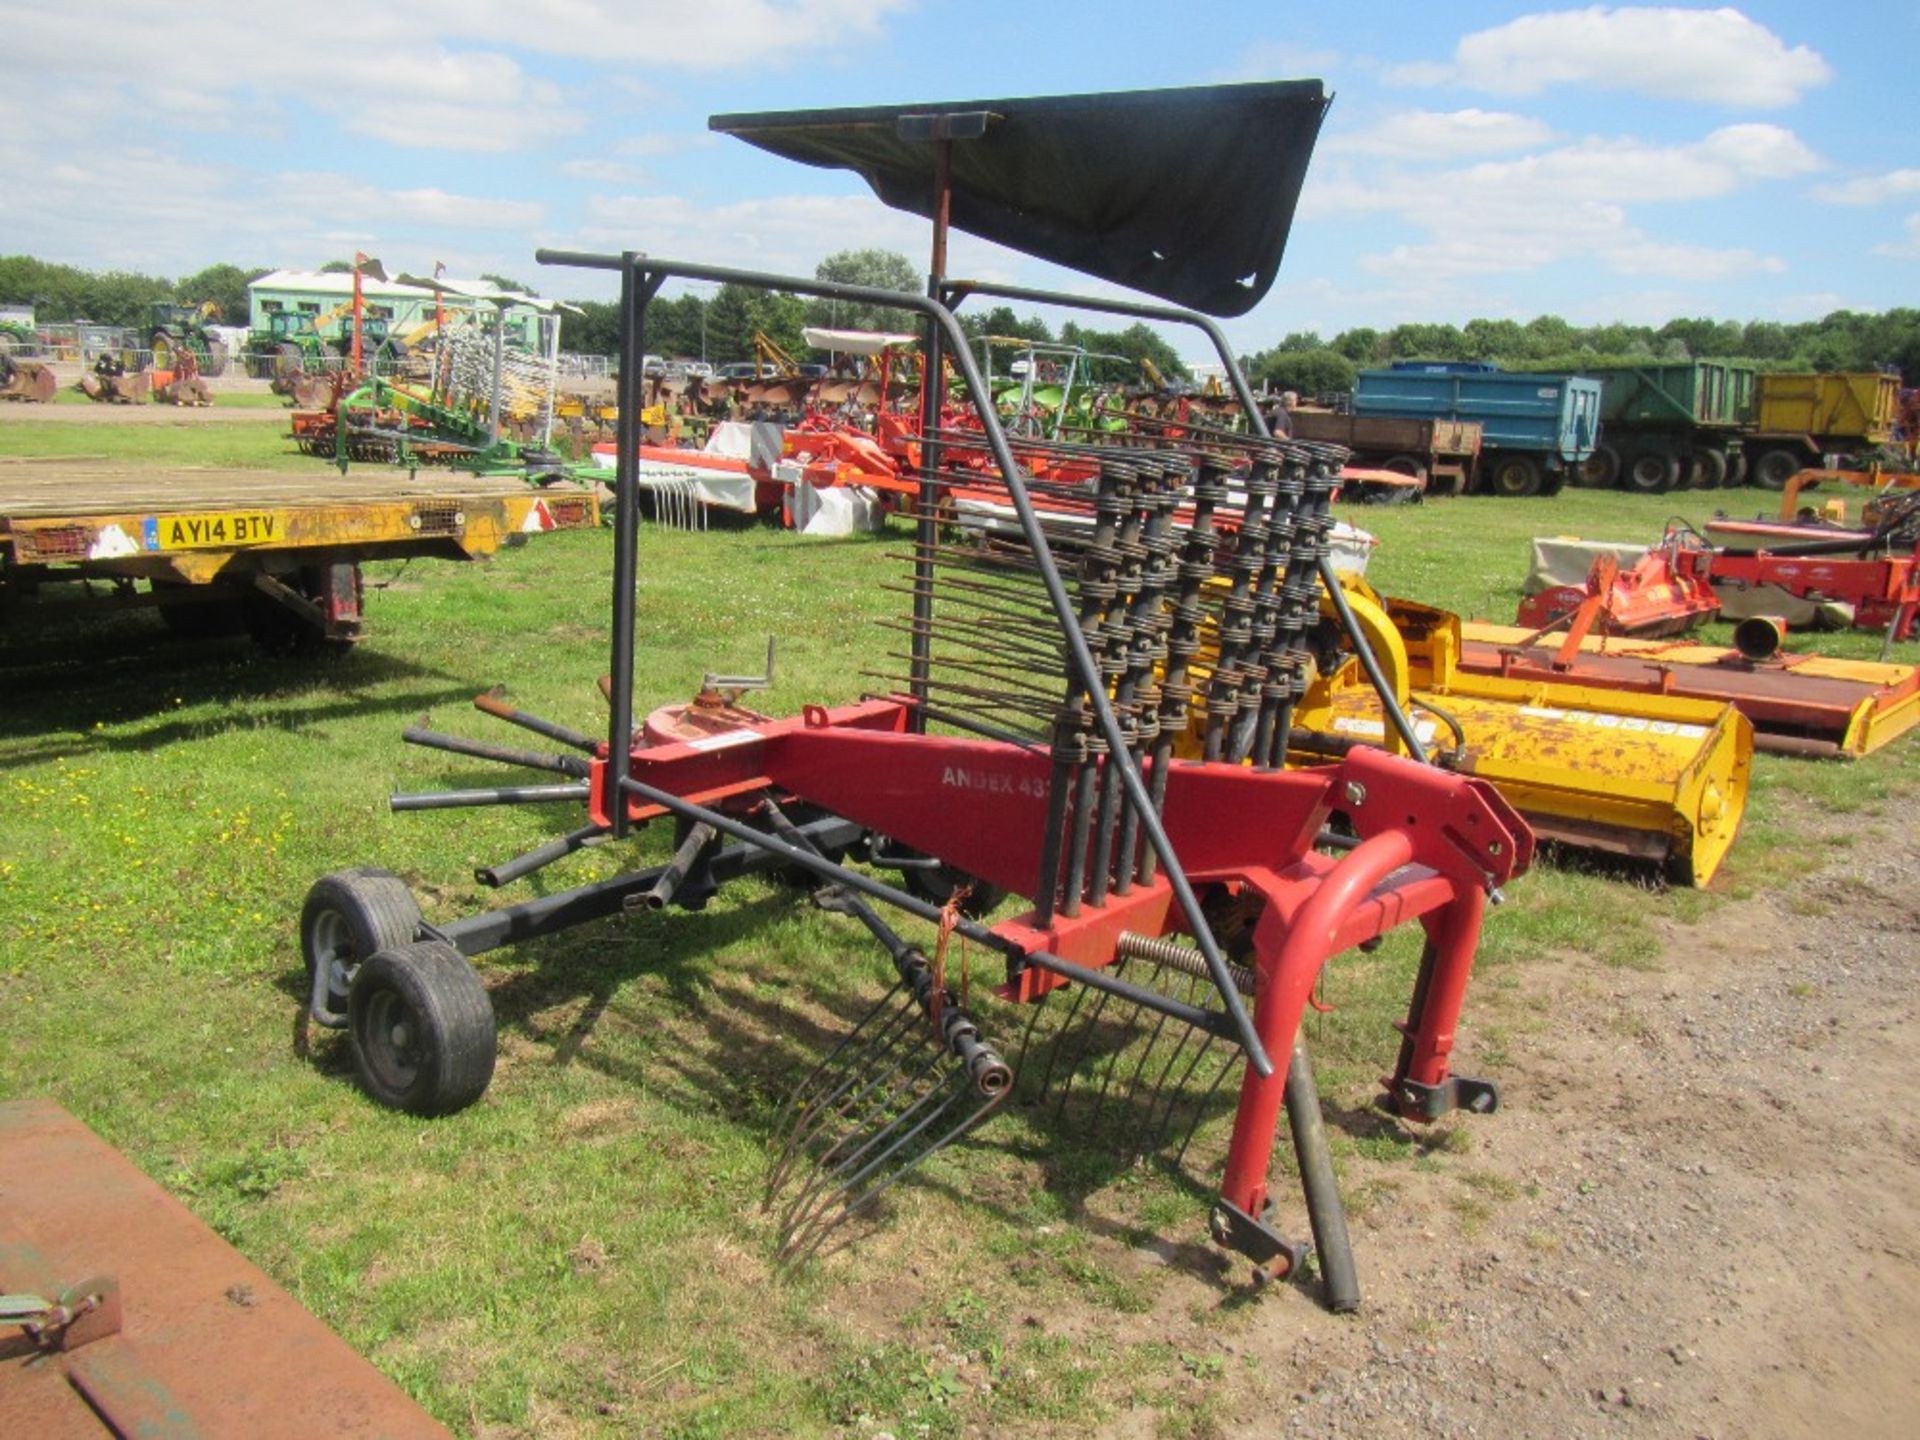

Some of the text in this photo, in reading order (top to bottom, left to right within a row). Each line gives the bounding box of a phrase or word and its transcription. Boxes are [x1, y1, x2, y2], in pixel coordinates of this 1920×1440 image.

[171, 519, 225, 544] AY14
[233, 515, 274, 540] BTV
[942, 765, 1014, 795] ANDEX
